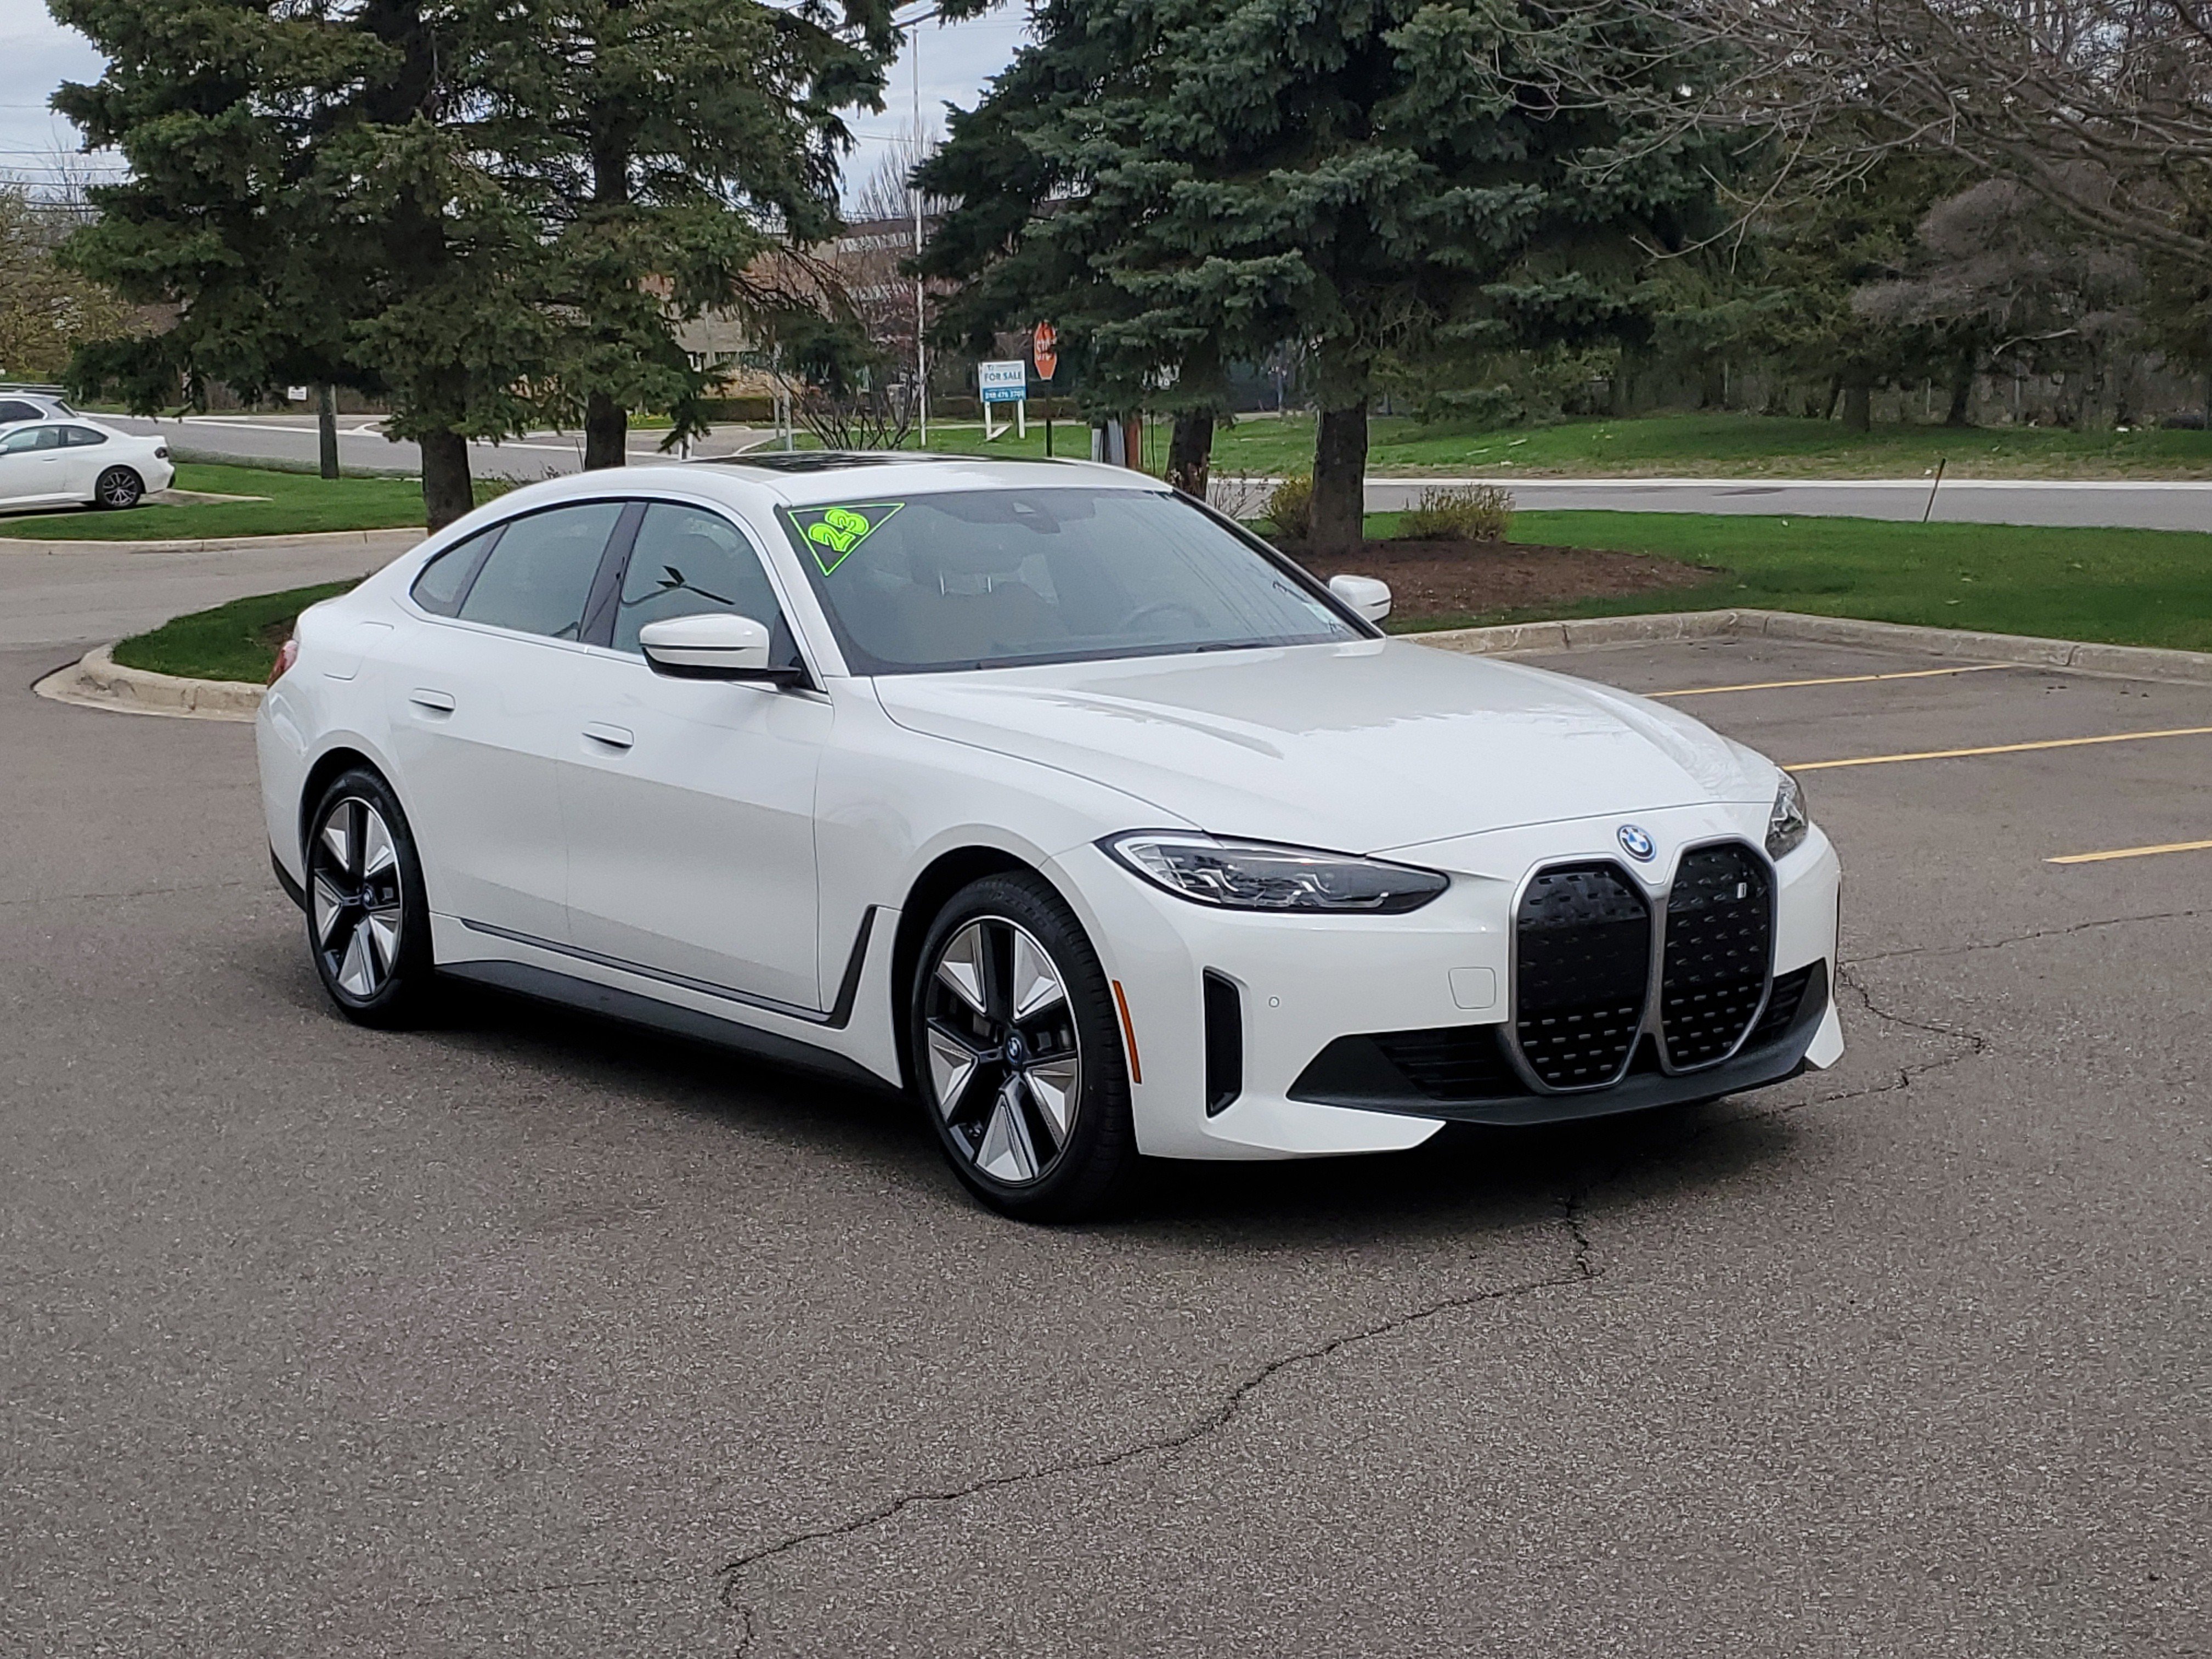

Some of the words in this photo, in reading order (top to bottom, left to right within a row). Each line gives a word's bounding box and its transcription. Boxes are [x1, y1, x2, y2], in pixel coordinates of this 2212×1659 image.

[984, 373, 1001, 382] FOR
[1003, 371, 1022, 381] SALE
[808, 508, 869, 552] 23
